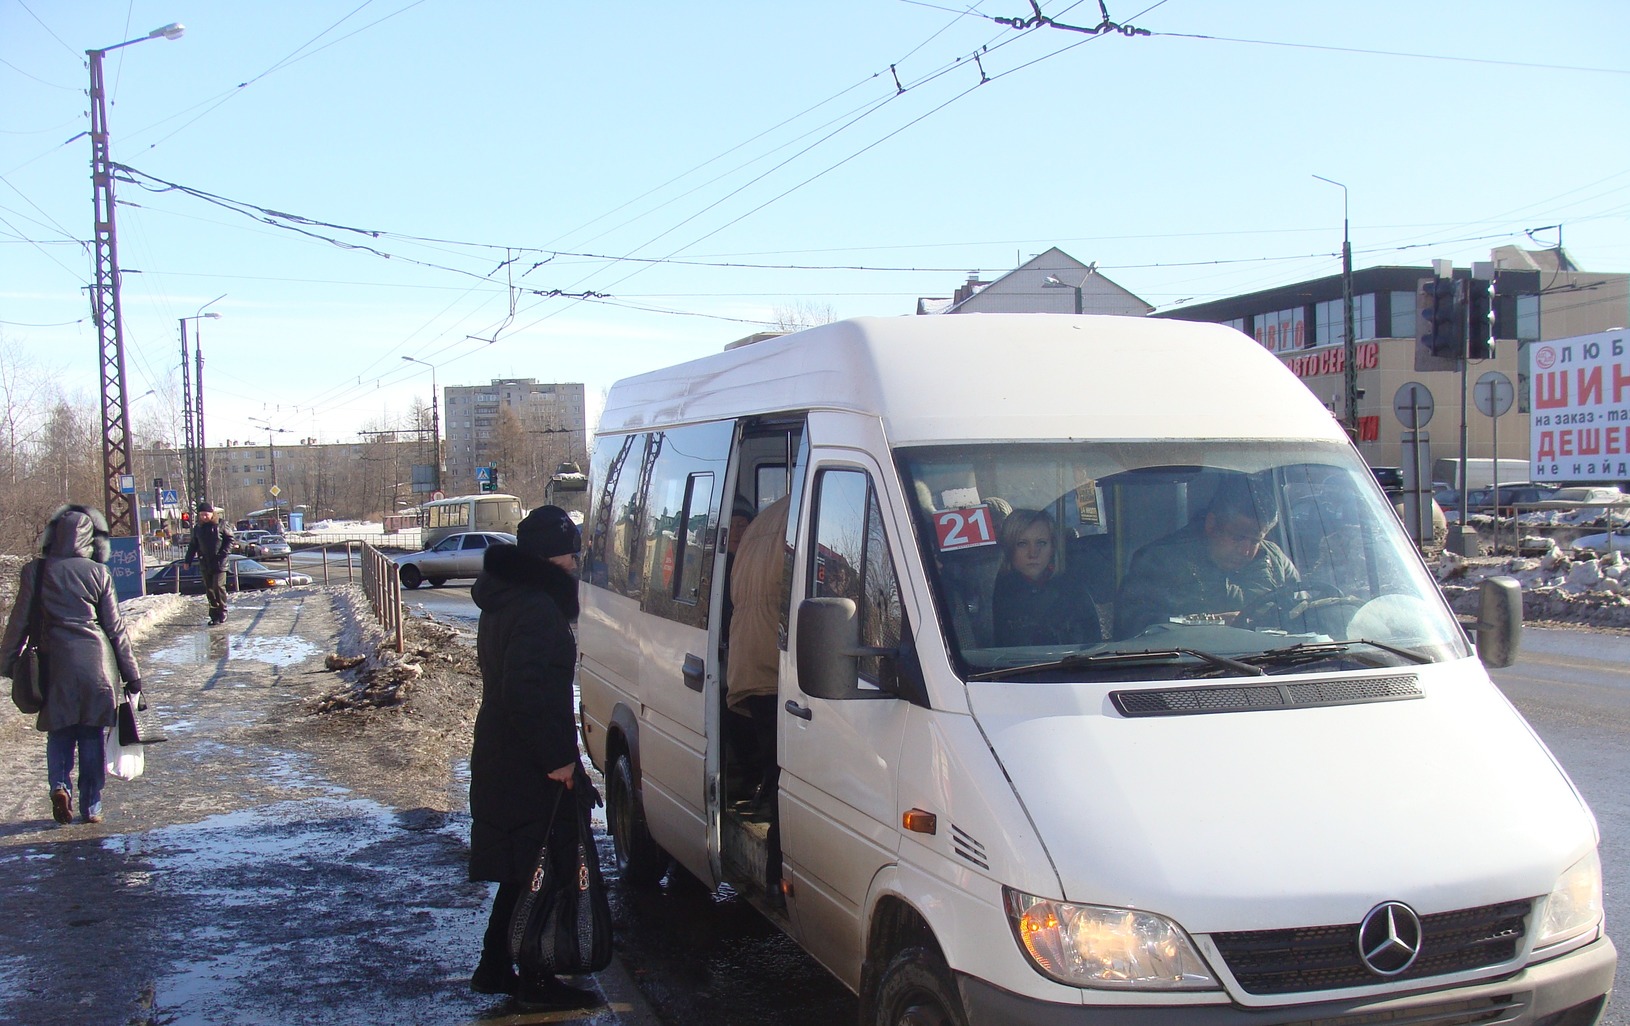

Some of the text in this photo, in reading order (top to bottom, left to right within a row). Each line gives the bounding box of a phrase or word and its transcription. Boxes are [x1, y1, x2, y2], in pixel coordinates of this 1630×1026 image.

[1561, 339, 1624, 363] ЛЮБ
[1535, 363, 1630, 410] ШИН
[1535, 414, 1550, 426] на
[1554, 412, 1594, 425] заказ
[1537, 459, 1627, 477] не найд
[939, 508, 990, 547] 21
